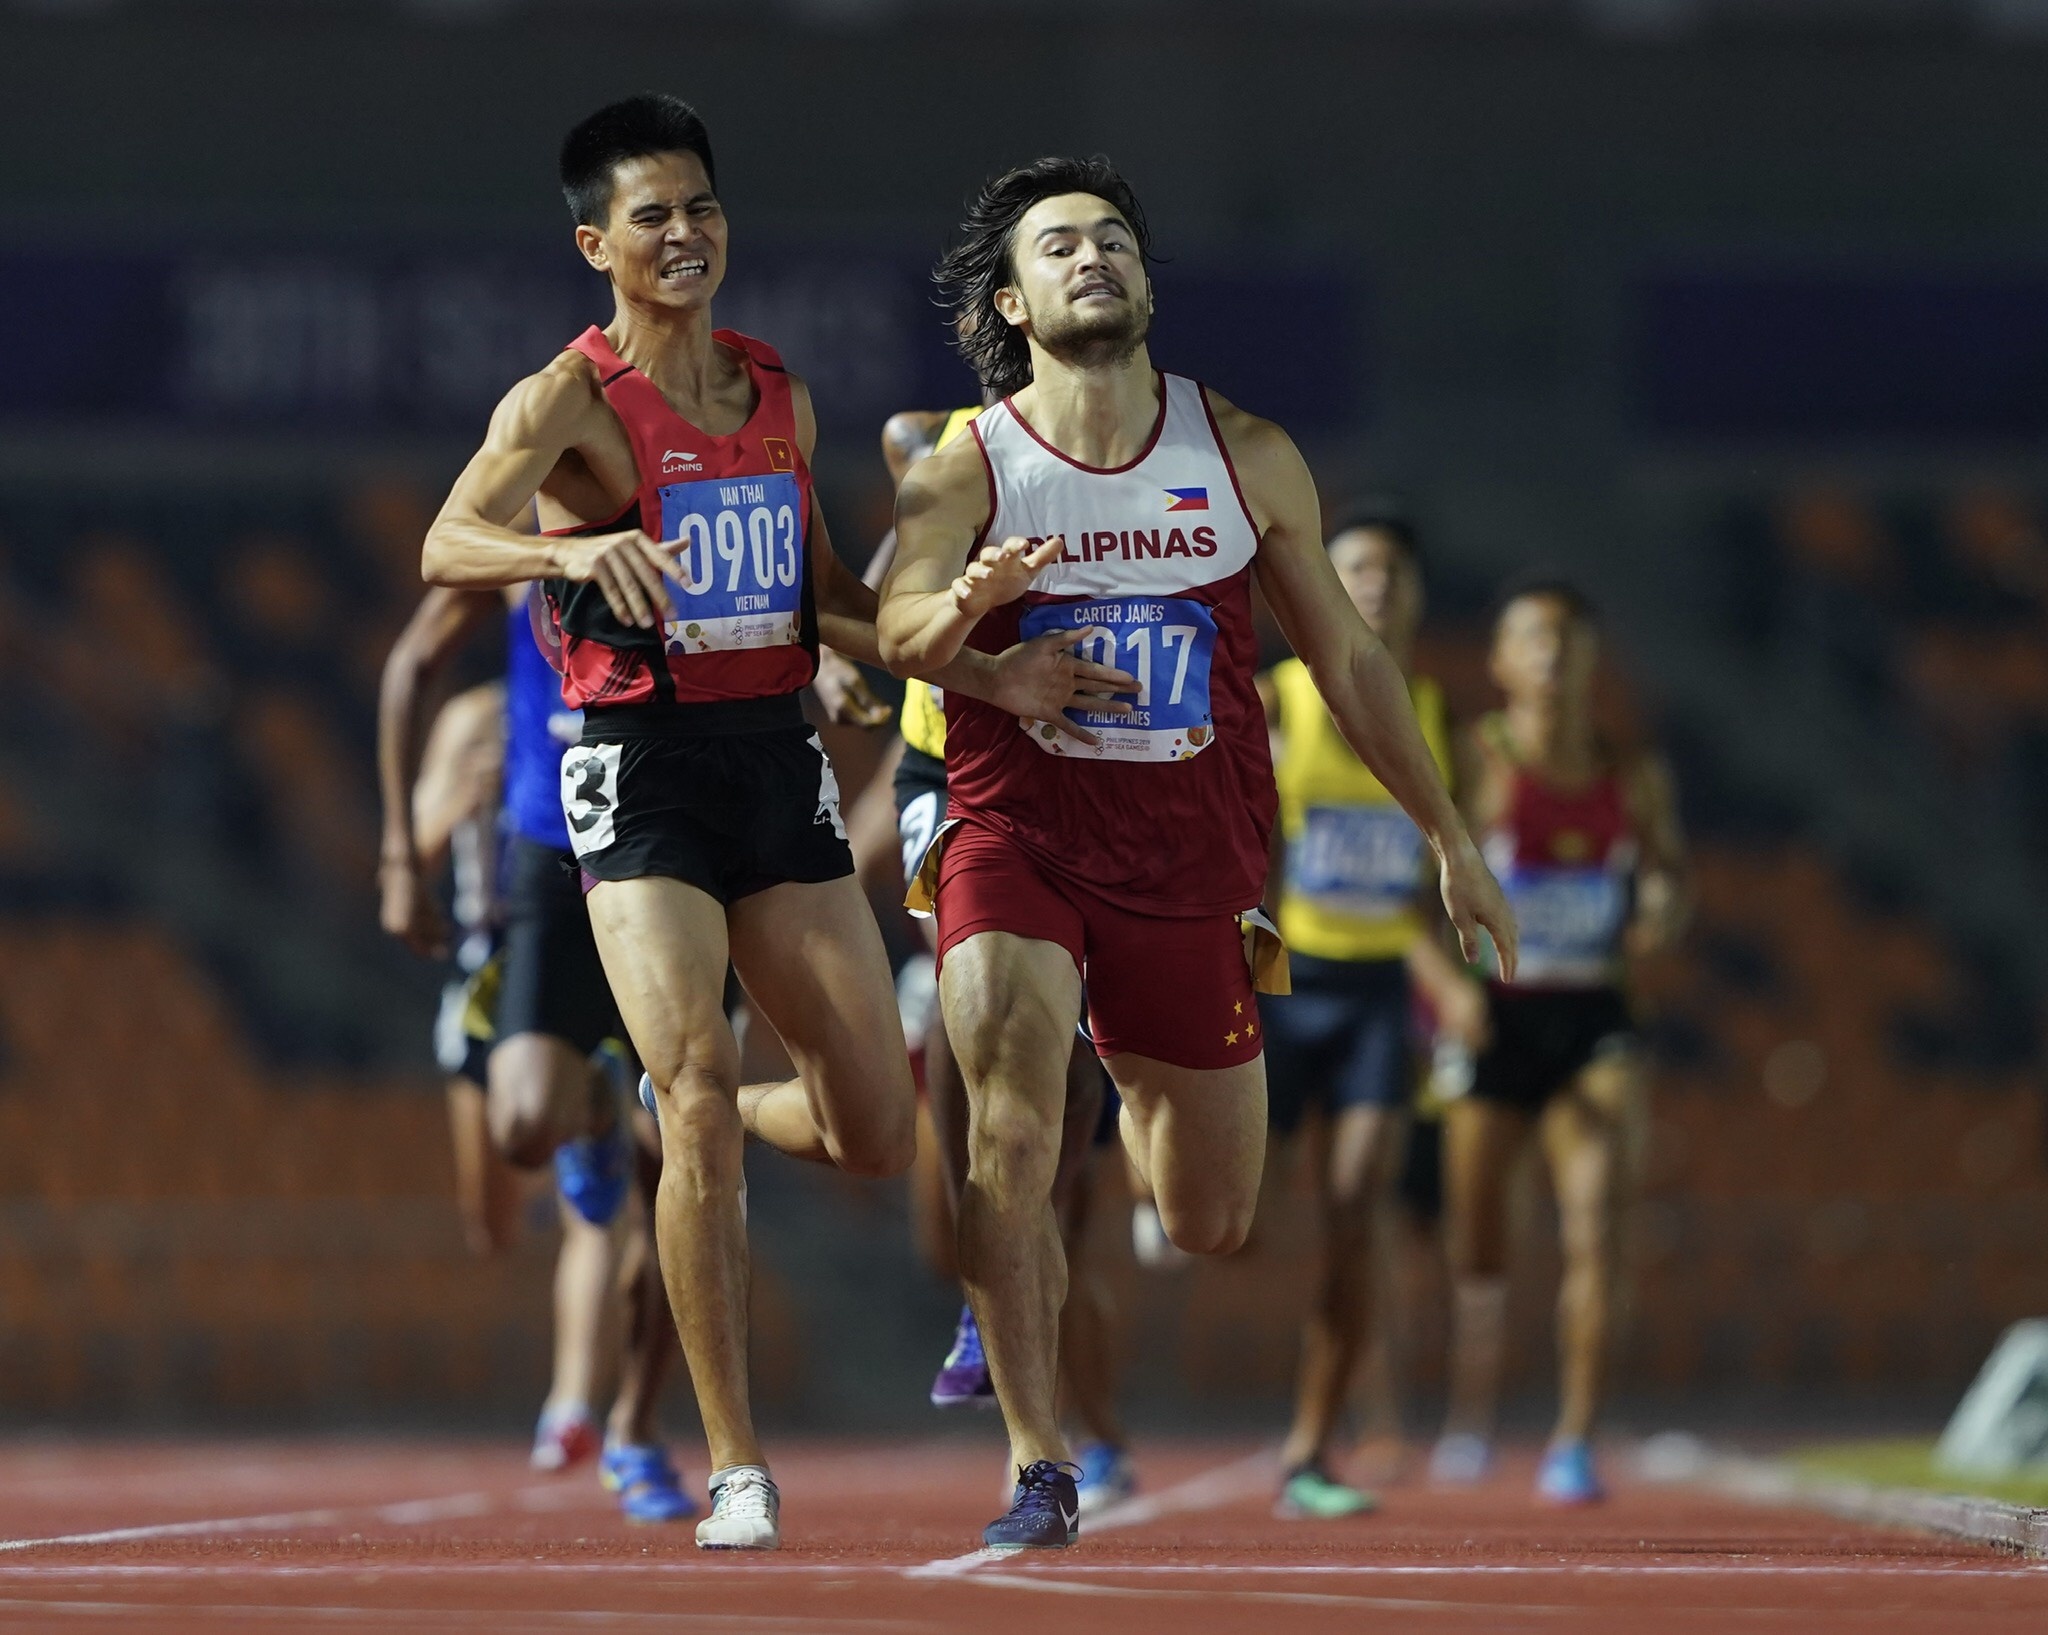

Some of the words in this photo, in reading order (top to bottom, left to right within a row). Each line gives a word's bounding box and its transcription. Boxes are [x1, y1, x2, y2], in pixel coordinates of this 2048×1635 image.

[662, 463, 703, 473] LI-NING
[719, 486, 740, 506] VAN
[741, 484, 765, 504] THAI
[678, 504, 796, 596] 0903
[736, 594, 769, 611] VIETNAM
[1074, 605, 1122, 624] CARTER
[1125, 603, 1165, 624] JAMES
[1040, 625, 1198, 707] 017
[565, 755, 611, 834] 3
